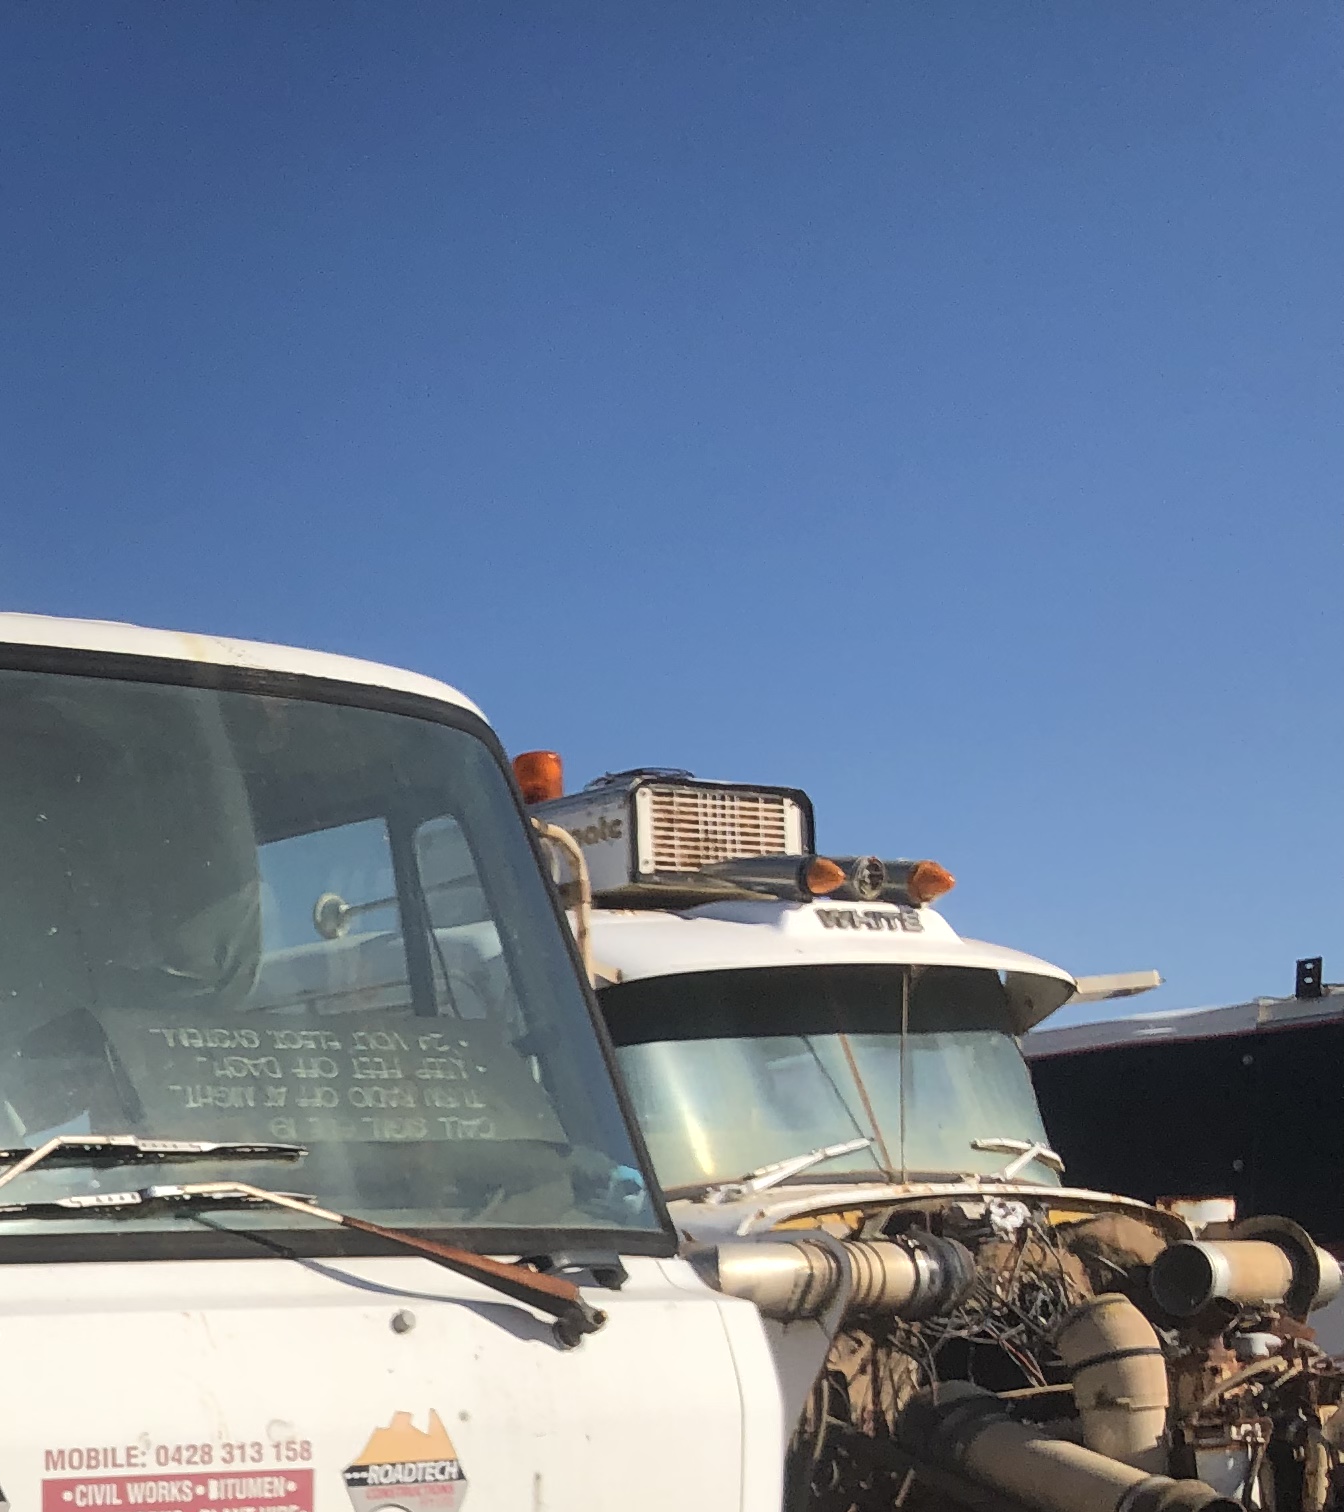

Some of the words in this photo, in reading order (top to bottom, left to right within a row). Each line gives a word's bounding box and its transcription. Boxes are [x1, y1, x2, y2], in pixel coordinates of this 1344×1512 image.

[814, 905, 924, 932] WHITE
[291, 1057, 339, 1078] OFF
[45, 1445, 147, 1471] MOBILE:
[155, 1443, 214, 1467] 0428
[221, 1441, 264, 1464] 313
[272, 1439, 312, 1462] 158
[367, 1460, 459, 1485] ROADTECH
[74, 1482, 123, 1507] CIVIL
